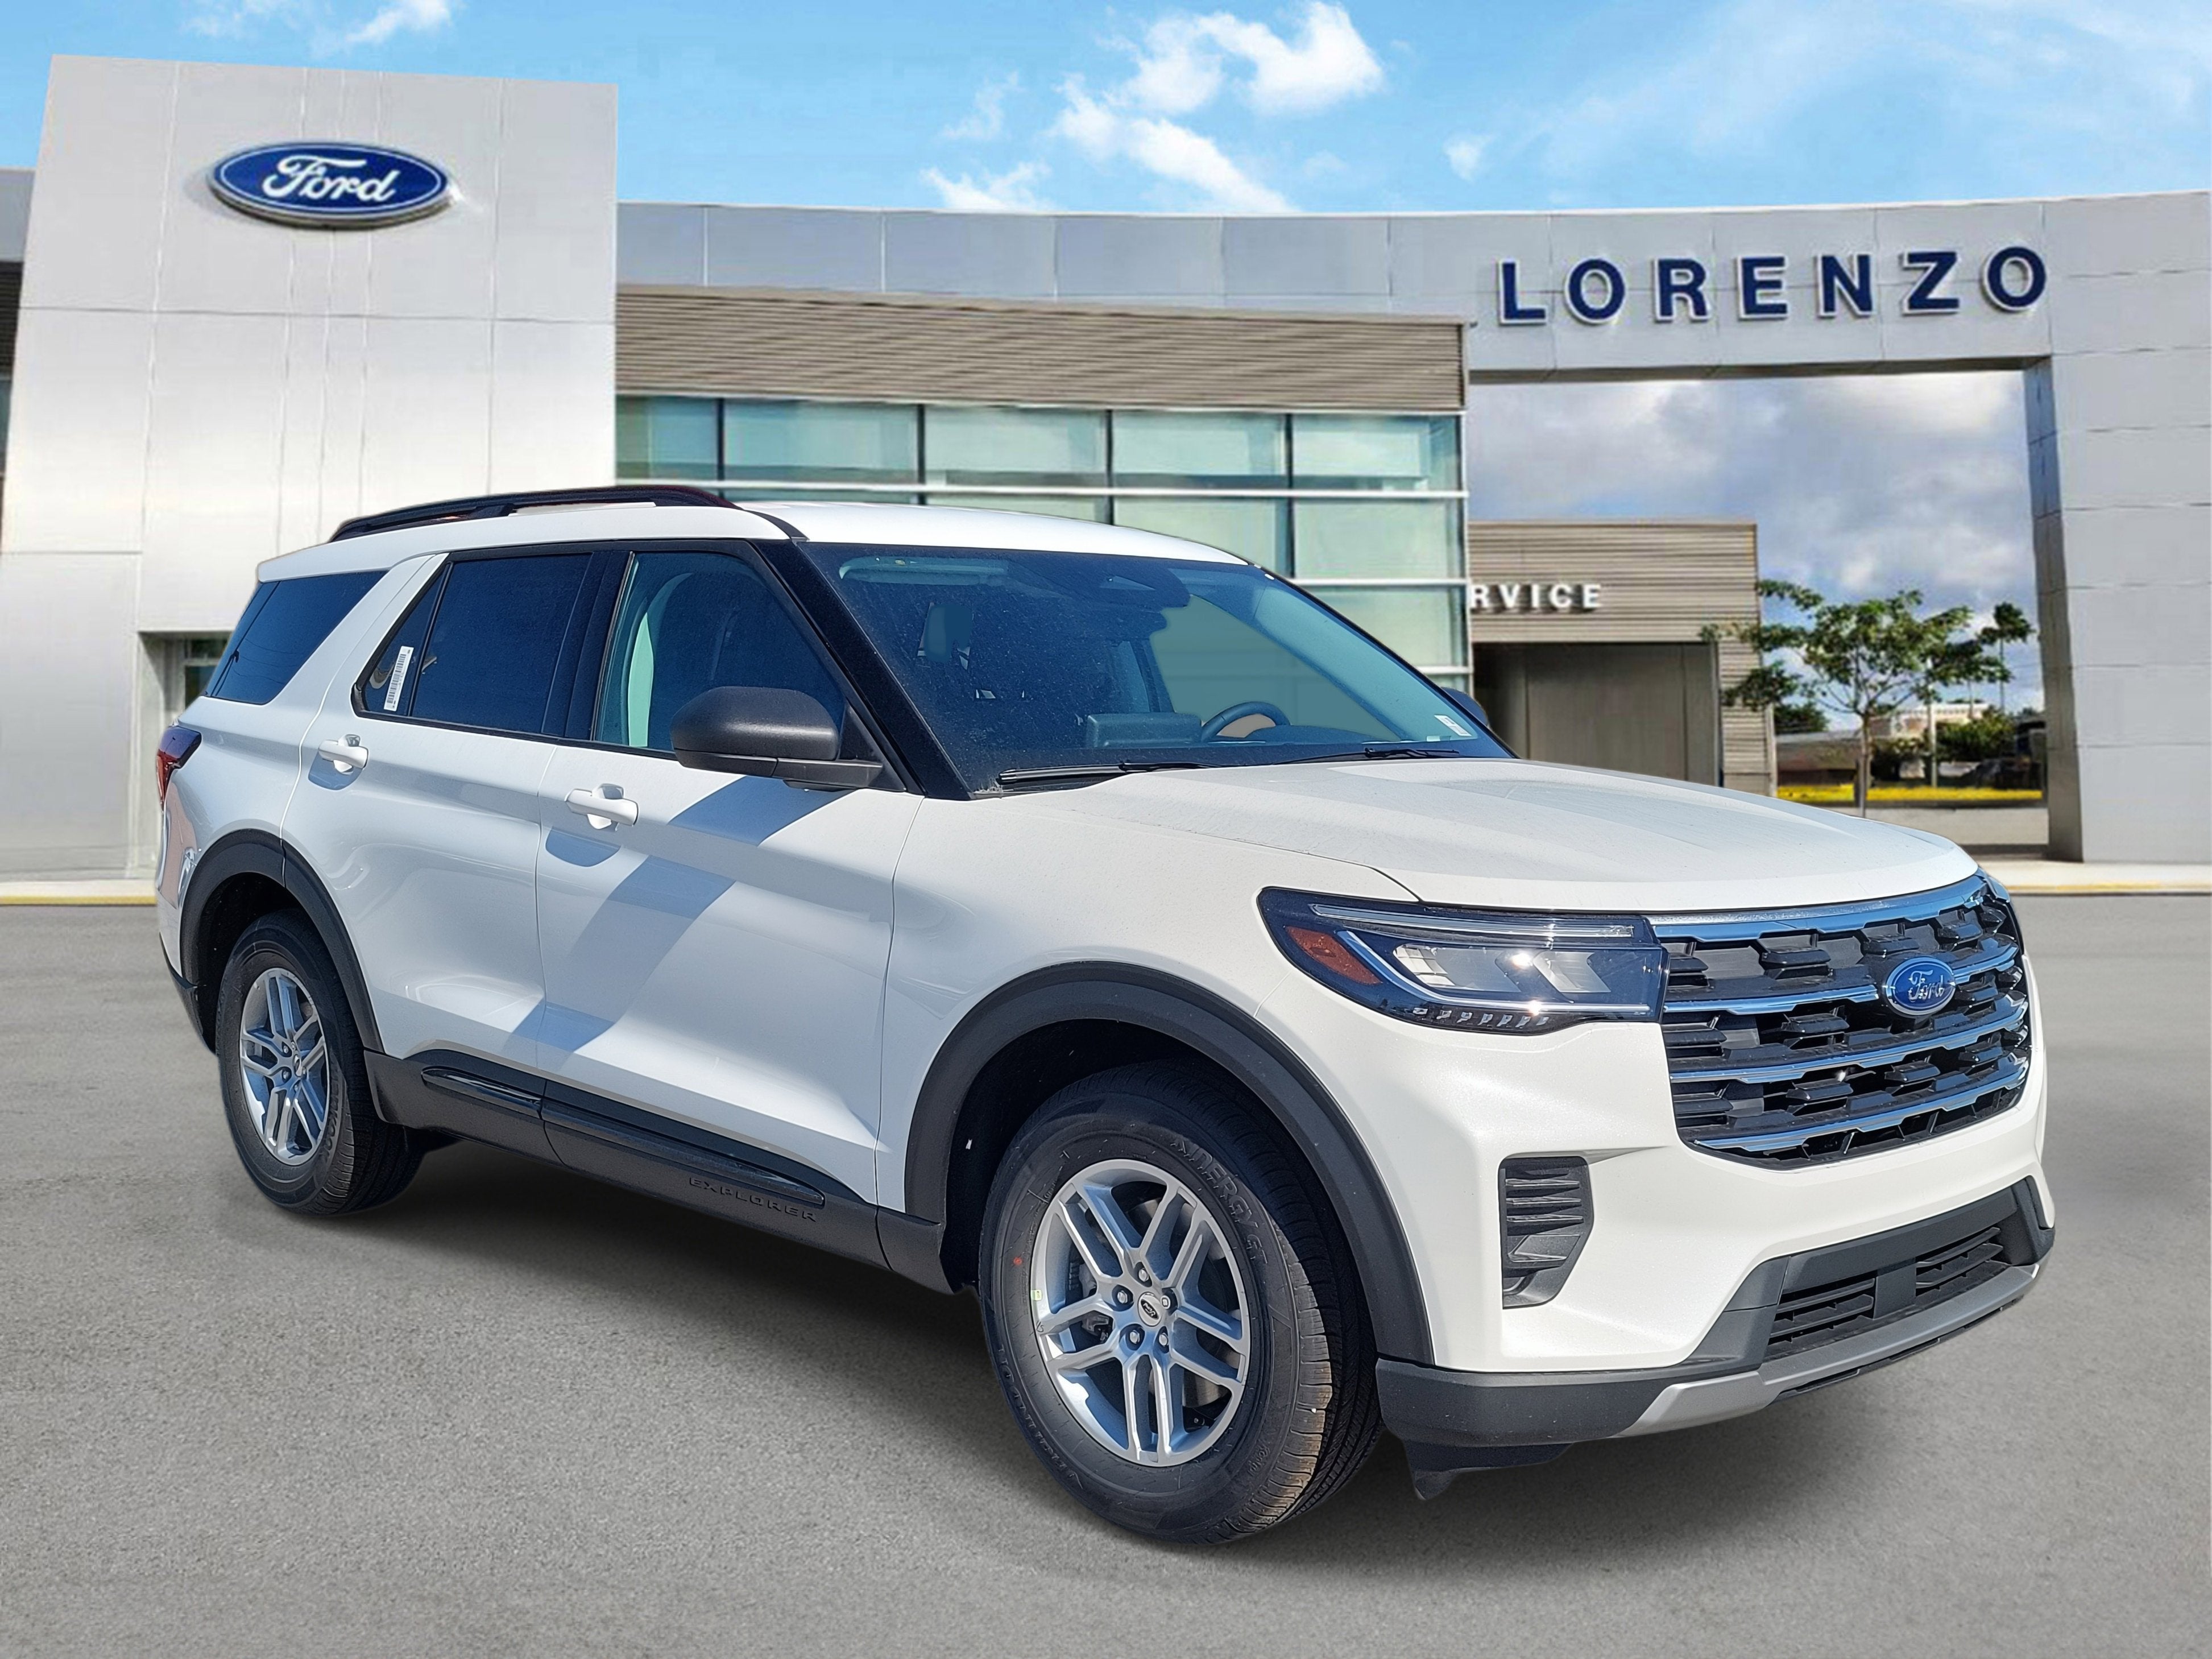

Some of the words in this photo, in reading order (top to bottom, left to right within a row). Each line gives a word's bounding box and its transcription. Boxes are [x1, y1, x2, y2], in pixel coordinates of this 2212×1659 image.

[262, 155, 400, 202] Ford
[1499, 246, 2047, 323] LORENZO
[1470, 584, 1602, 608] RVICE
[1908, 969, 1945, 1003] Ford
[689, 1177, 817, 1223] EXPLORER
